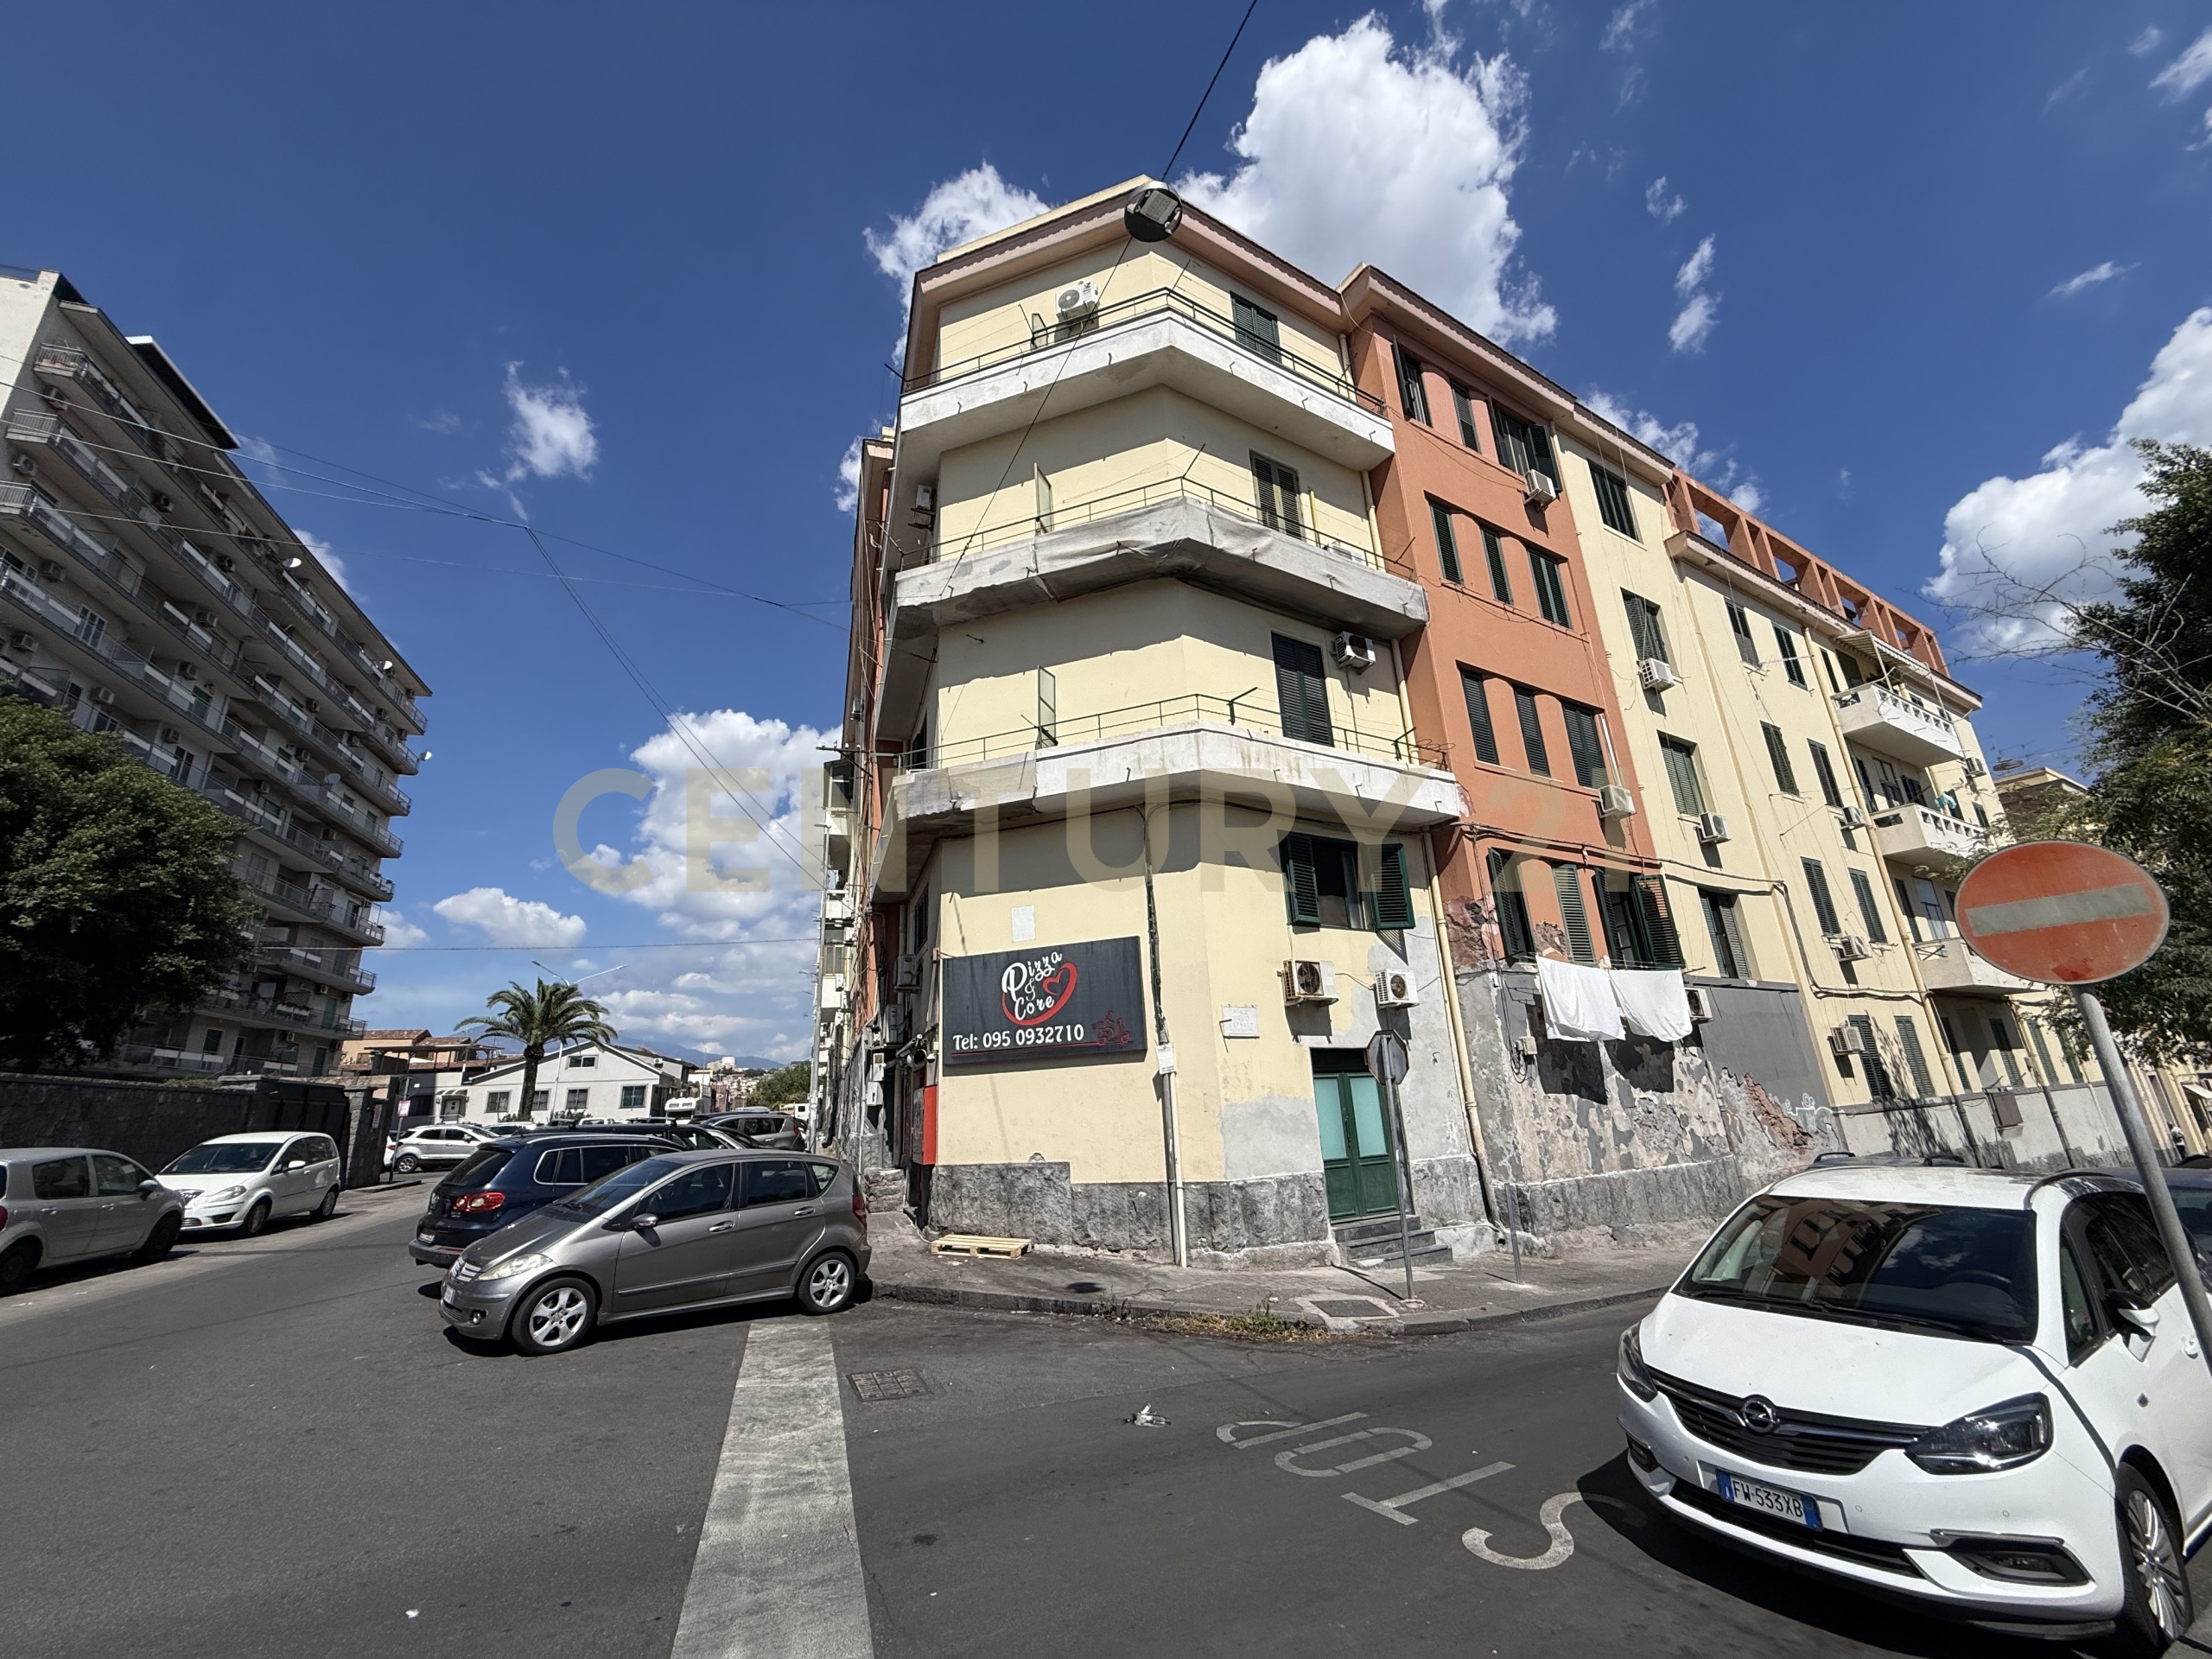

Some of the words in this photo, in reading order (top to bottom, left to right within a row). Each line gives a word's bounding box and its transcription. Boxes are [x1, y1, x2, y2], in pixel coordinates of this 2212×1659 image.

[1001, 951, 1063, 1001] Pizza
[1025, 977, 1035, 1001] &
[1014, 995, 1055, 1021] Core
[953, 1033, 978, 1051] Tel:
[982, 1031, 1011, 1048] 095
[1015, 1024, 1084, 1046] 0932710
[1216, 1412, 1647, 1570] STOP
